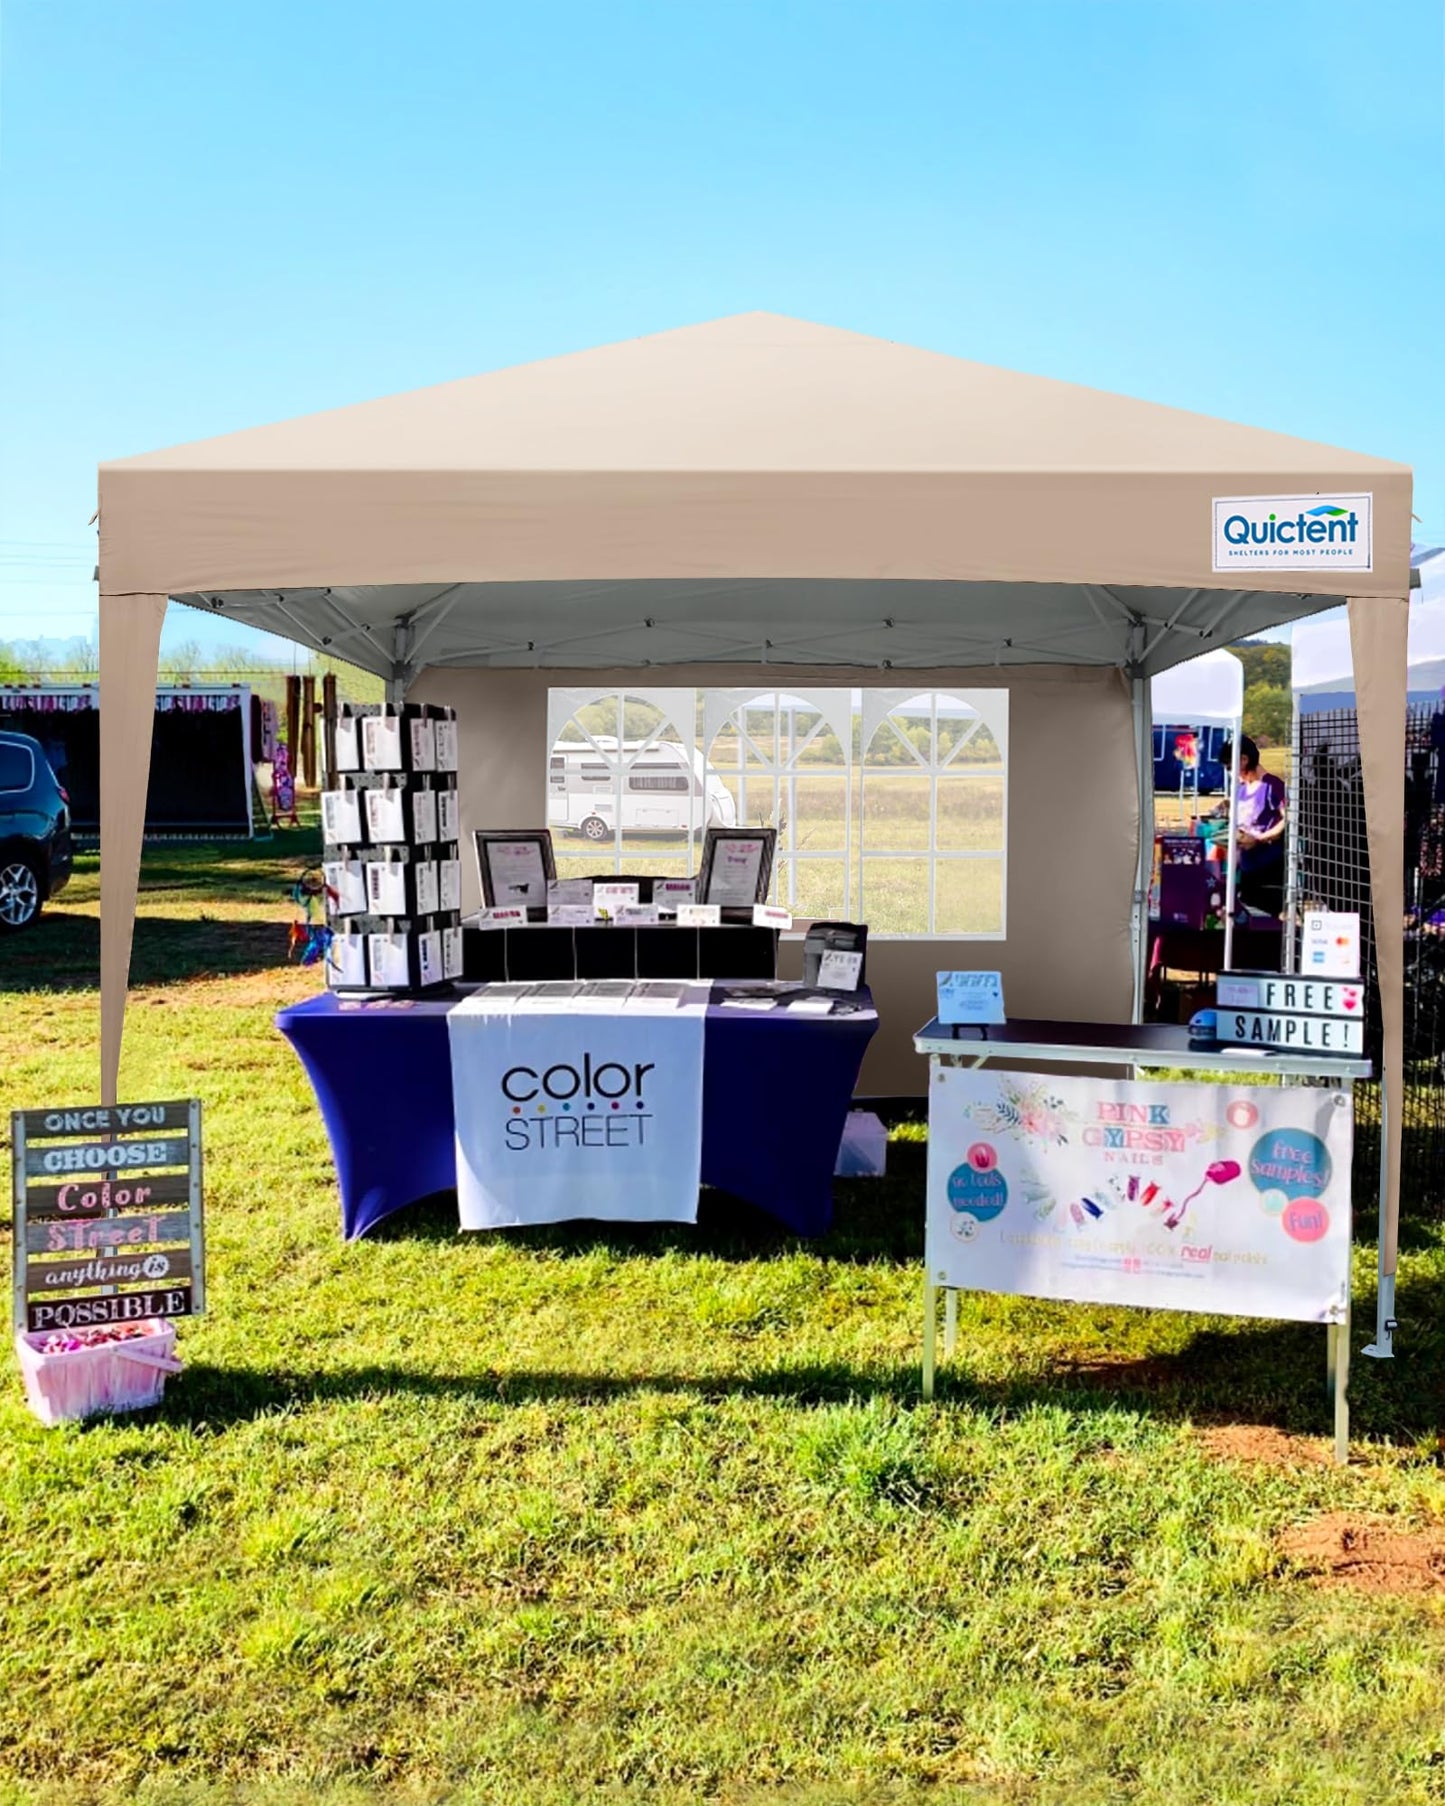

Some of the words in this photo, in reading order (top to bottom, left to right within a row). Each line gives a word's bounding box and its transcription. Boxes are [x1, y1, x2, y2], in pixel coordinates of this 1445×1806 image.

[1224, 512, 1358, 544] Quictent
[1266, 982, 1333, 1010] FREE
[1235, 1015, 1349, 1048] SAMPLE!
[501, 1052, 655, 1102] color
[44, 1110, 111, 1131] ONCE
[116, 1106, 165, 1127] YOU
[1097, 1101, 1170, 1124] PINK
[505, 1114, 653, 1150] STREET
[1082, 1127, 1186, 1152] GYPSY
[44, 1142, 167, 1172] CHOOSE
[1104, 1151, 1163, 1166] NAILS
[57, 1182, 152, 1211] Color
[1181, 1245, 1213, 1261] real
[45, 1261, 143, 1286] anything
[148, 1257, 166, 1273] is
[33, 1291, 185, 1329] POSSIBLE
